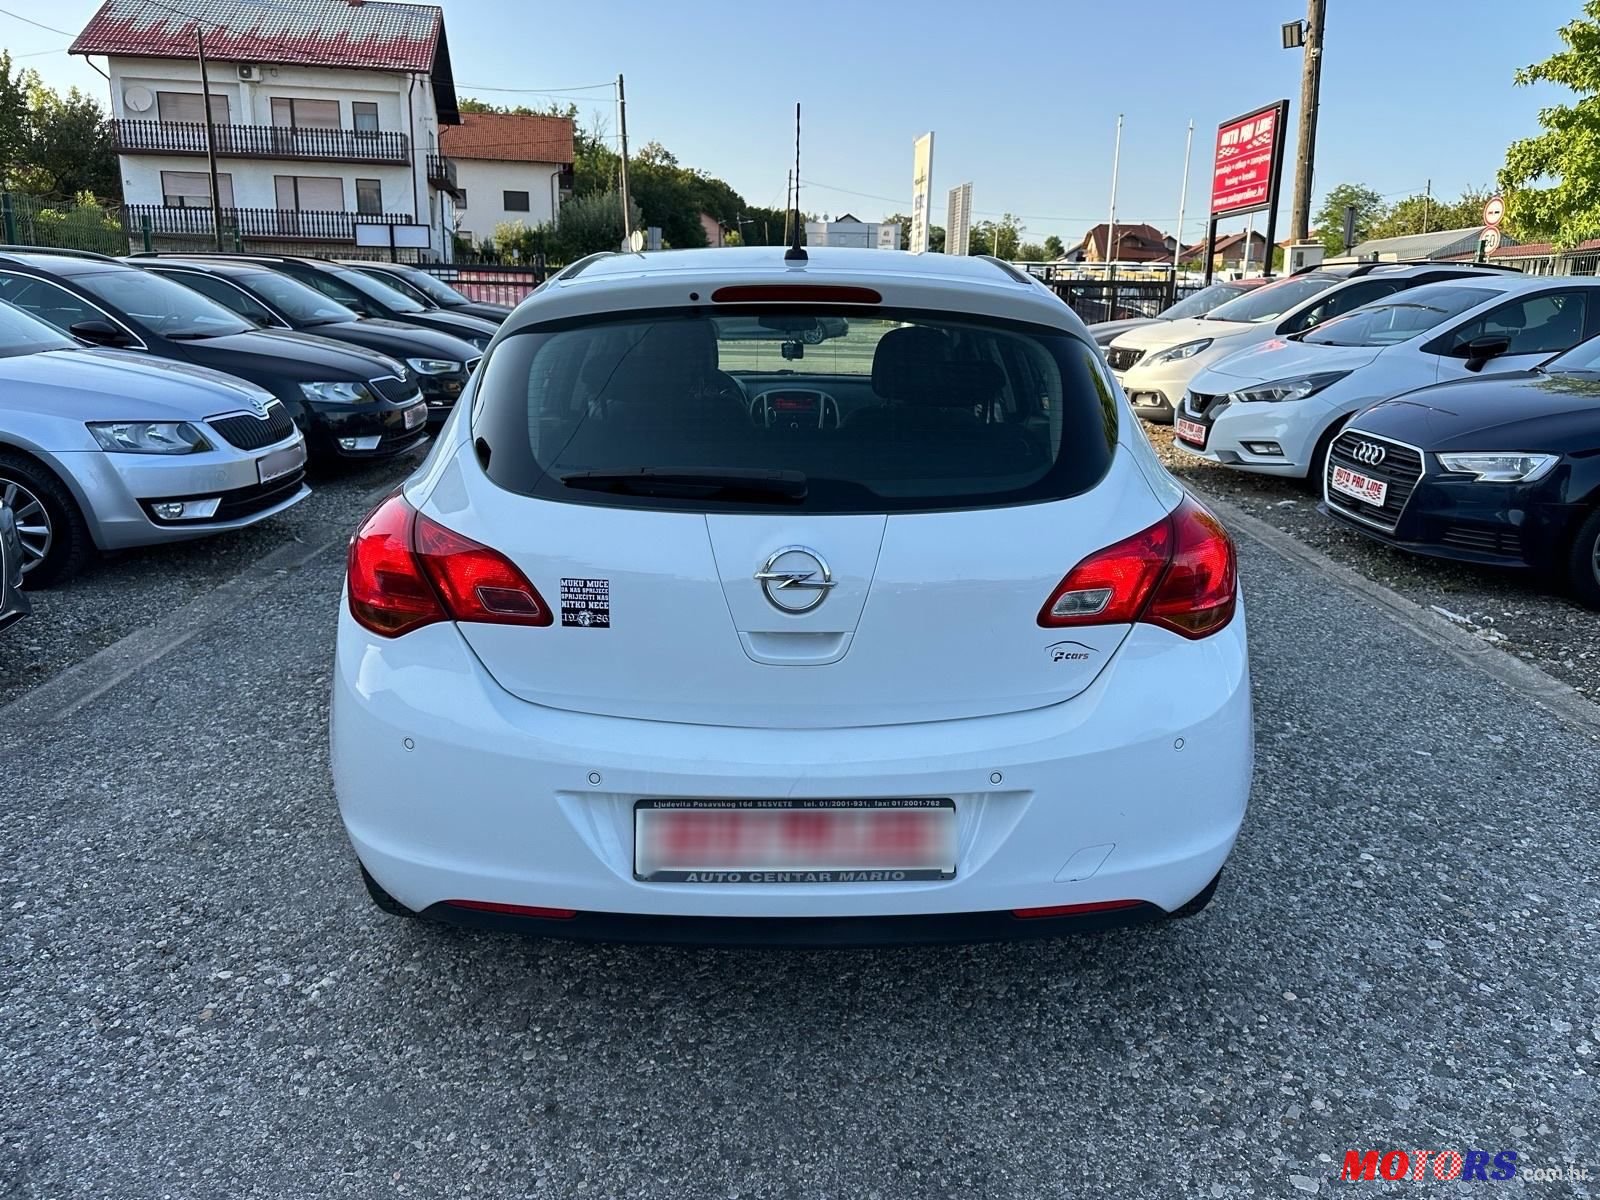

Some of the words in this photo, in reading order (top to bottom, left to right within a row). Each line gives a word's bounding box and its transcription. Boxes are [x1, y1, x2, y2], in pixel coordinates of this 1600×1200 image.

[1221, 129, 1239, 146] AUTO
[1240, 123, 1255, 143] PRO
[1255, 116, 1273, 137] LINE
[1336, 469, 1350, 482] AUTO
[1352, 475, 1365, 488] PRO
[1367, 480, 1383, 492] LINE
[685, 872, 742, 883] AUTO
[748, 872, 831, 883] CENTAR
[838, 871, 906, 882] MARIO
